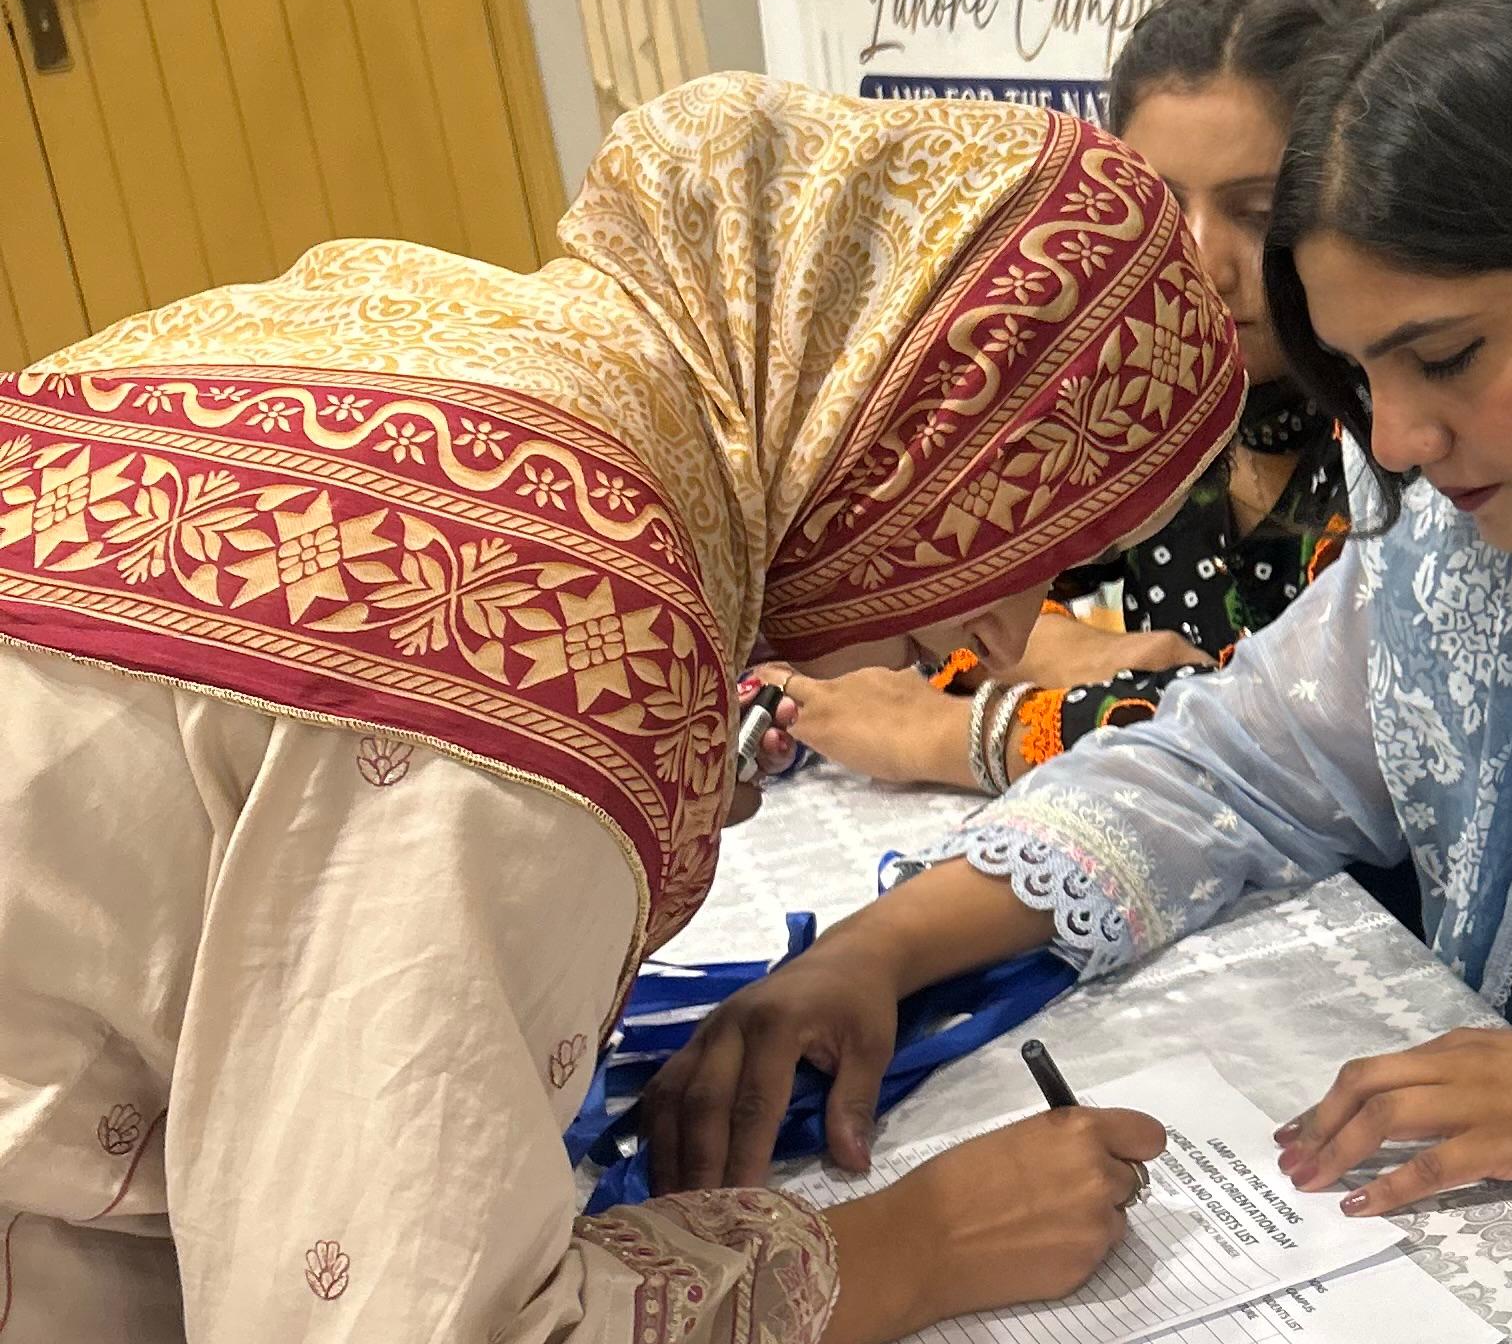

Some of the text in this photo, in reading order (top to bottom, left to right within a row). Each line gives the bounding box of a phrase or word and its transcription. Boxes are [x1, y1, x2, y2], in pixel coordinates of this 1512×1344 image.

[1159, 1150, 1260, 1246] UDENTS AND GUESTS LIST
[1188, 1150, 1228, 1184] CAMPUS
[1220, 1182, 1277, 1234] ORIENTATION
[1271, 1232, 1298, 1250] DAY
[1207, 1137, 1303, 1225] LAMP FOR THE NATIONS
[1285, 1318, 1304, 1331] LIST
